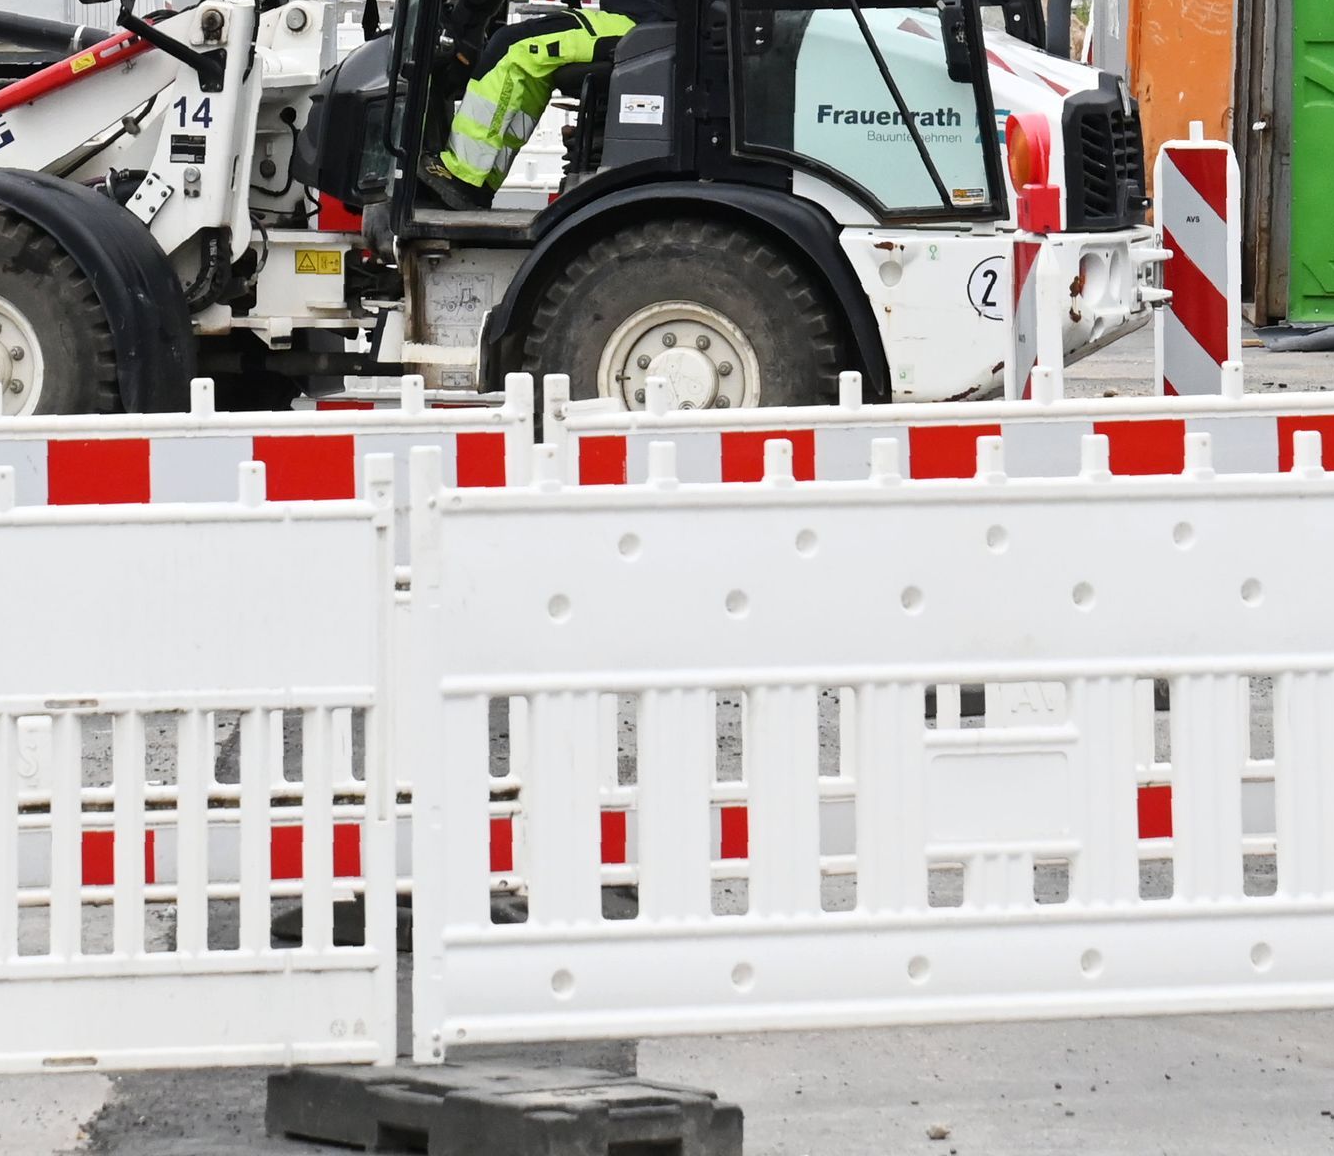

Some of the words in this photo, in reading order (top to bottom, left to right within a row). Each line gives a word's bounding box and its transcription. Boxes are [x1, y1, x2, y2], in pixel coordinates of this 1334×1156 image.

[173, 96, 213, 128] 14
[817, 104, 961, 126] Frauenrath
[867, 130, 962, 143] Bauuntenehmen
[982, 269, 998, 307] 2
